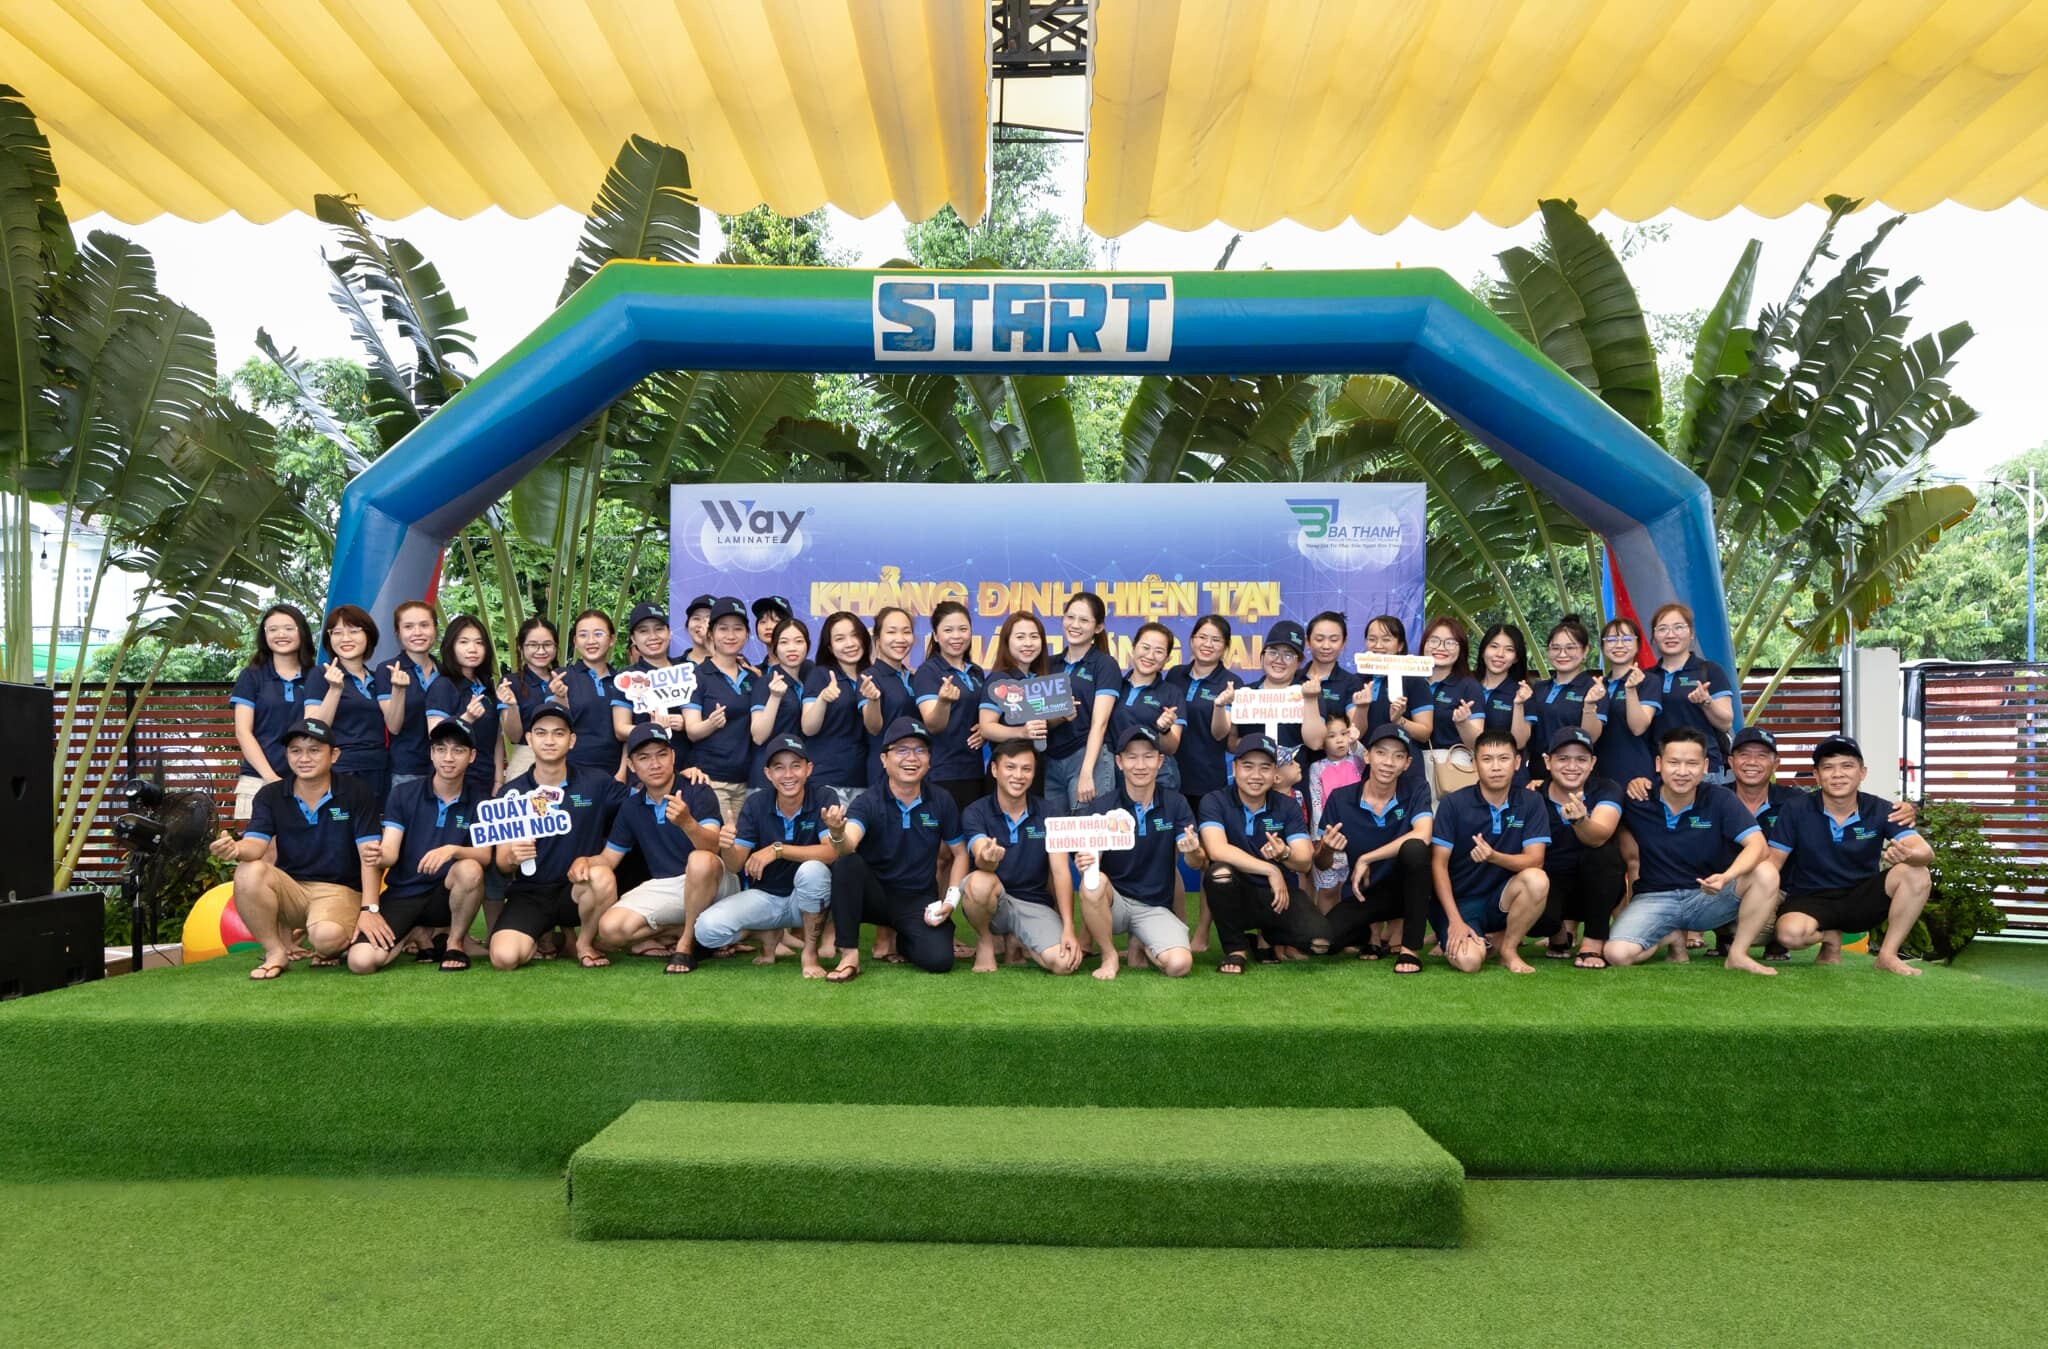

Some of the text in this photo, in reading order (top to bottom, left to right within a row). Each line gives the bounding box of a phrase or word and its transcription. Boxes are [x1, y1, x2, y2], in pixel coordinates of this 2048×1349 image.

[878, 282, 1167, 353] START
[701, 499, 806, 544] Way
[717, 536, 780, 544] LAMINATE
[1328, 526, 1400, 538] BA THANH
[1203, 581, 1281, 624] TẠI
[650, 666, 692, 688] LOVE
[653, 686, 691, 700] Way
[1024, 678, 1066, 700] LOVE
[1259, 693, 1286, 704] NHAU
[1281, 704, 1304, 719] CƯỜ
[481, 793, 528, 822] QUẨY
[473, 821, 526, 844] BANH
[530, 813, 568, 836] NÓC
[1048, 817, 1108, 832] TEAM NHẬU
[1049, 836, 1086, 849] KHÔNG
